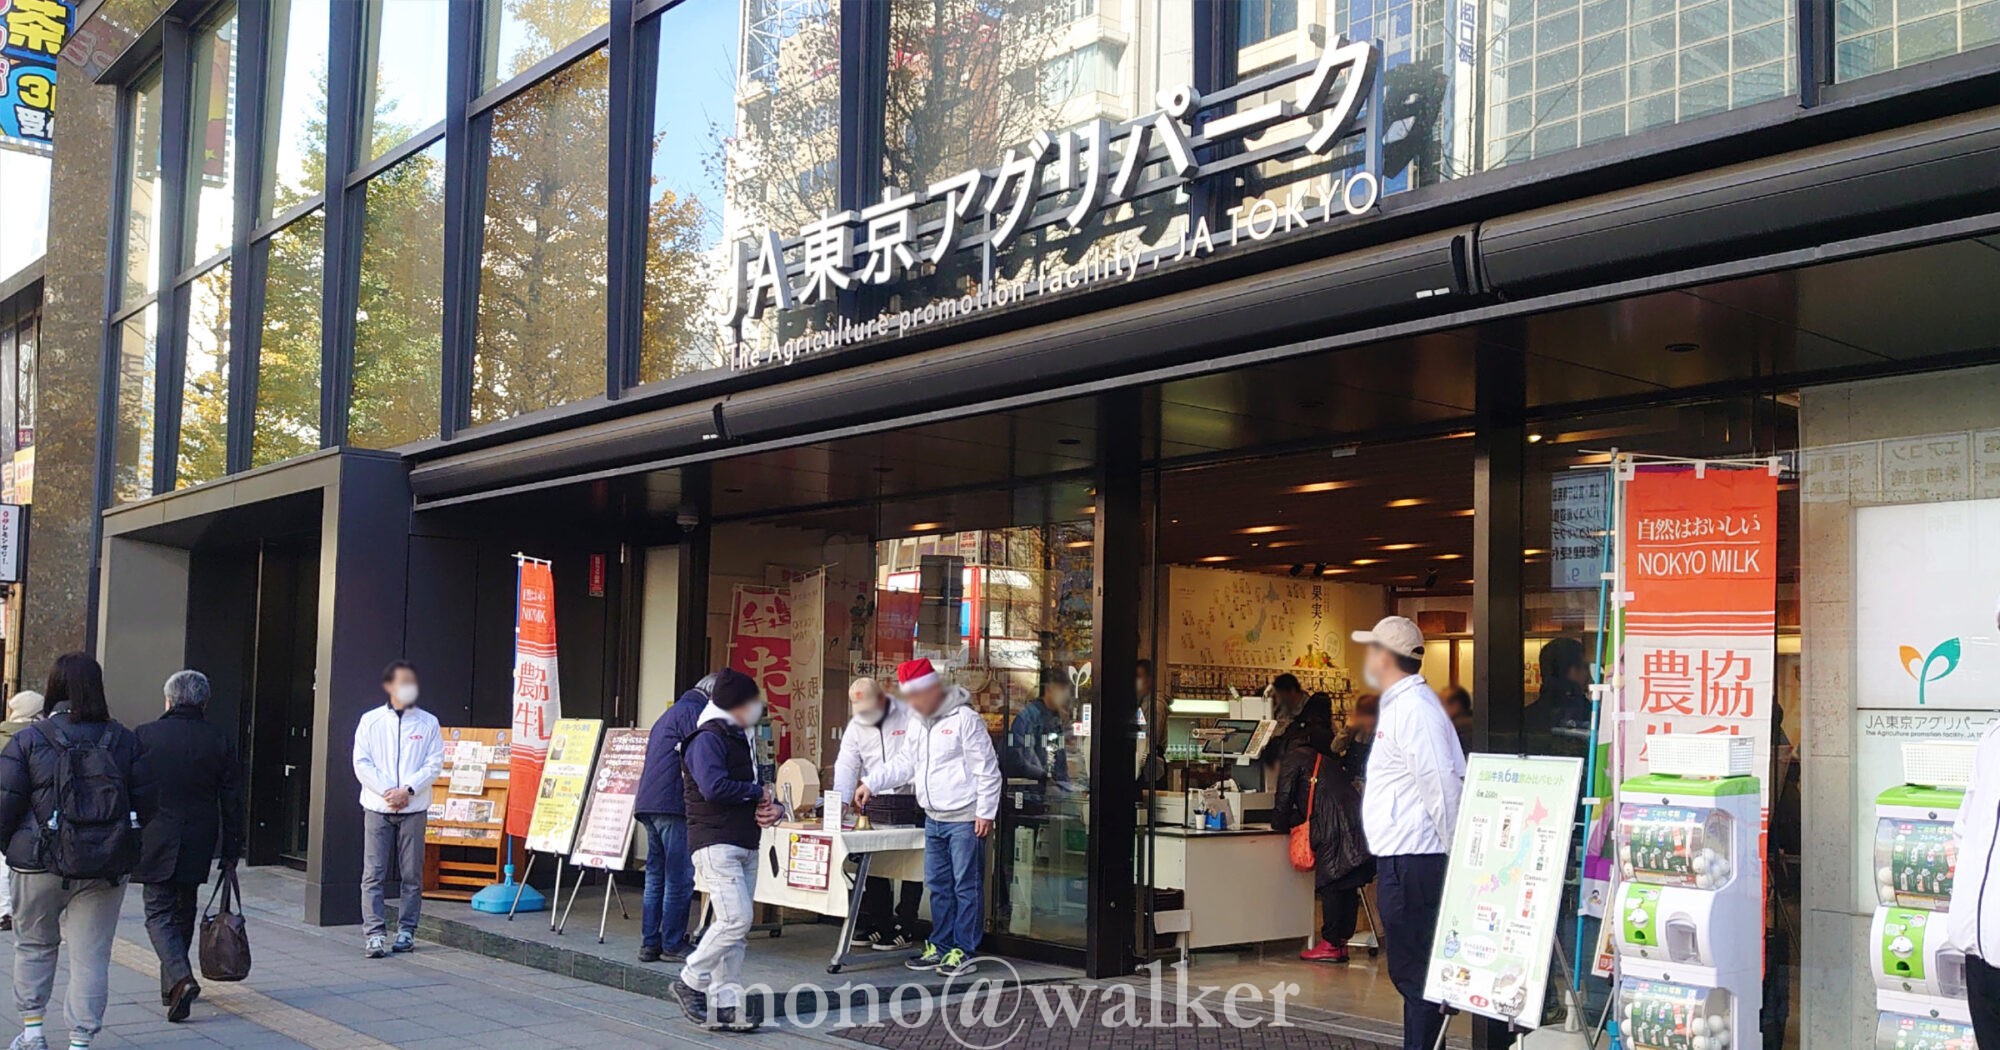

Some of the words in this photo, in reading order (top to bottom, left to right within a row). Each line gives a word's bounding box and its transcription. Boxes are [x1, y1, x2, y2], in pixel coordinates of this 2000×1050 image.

[712, 34, 1377, 327] JA東京アグリパーク
[728, 342, 761, 371] The
[768, 313, 889, 366] Agriculture
[899, 281, 1025, 338] promotion
[1174, 216, 1214, 261] JA
[1226, 172, 1379, 246] TOKYO
[1637, 515, 1761, 541] 自然はおいしい
[1637, 551, 1707, 576] NOKYO
[1711, 549, 1761, 574] MILK
[1312, 585, 1323, 647] 果実グミ
[1638, 649, 1754, 718] 農協
